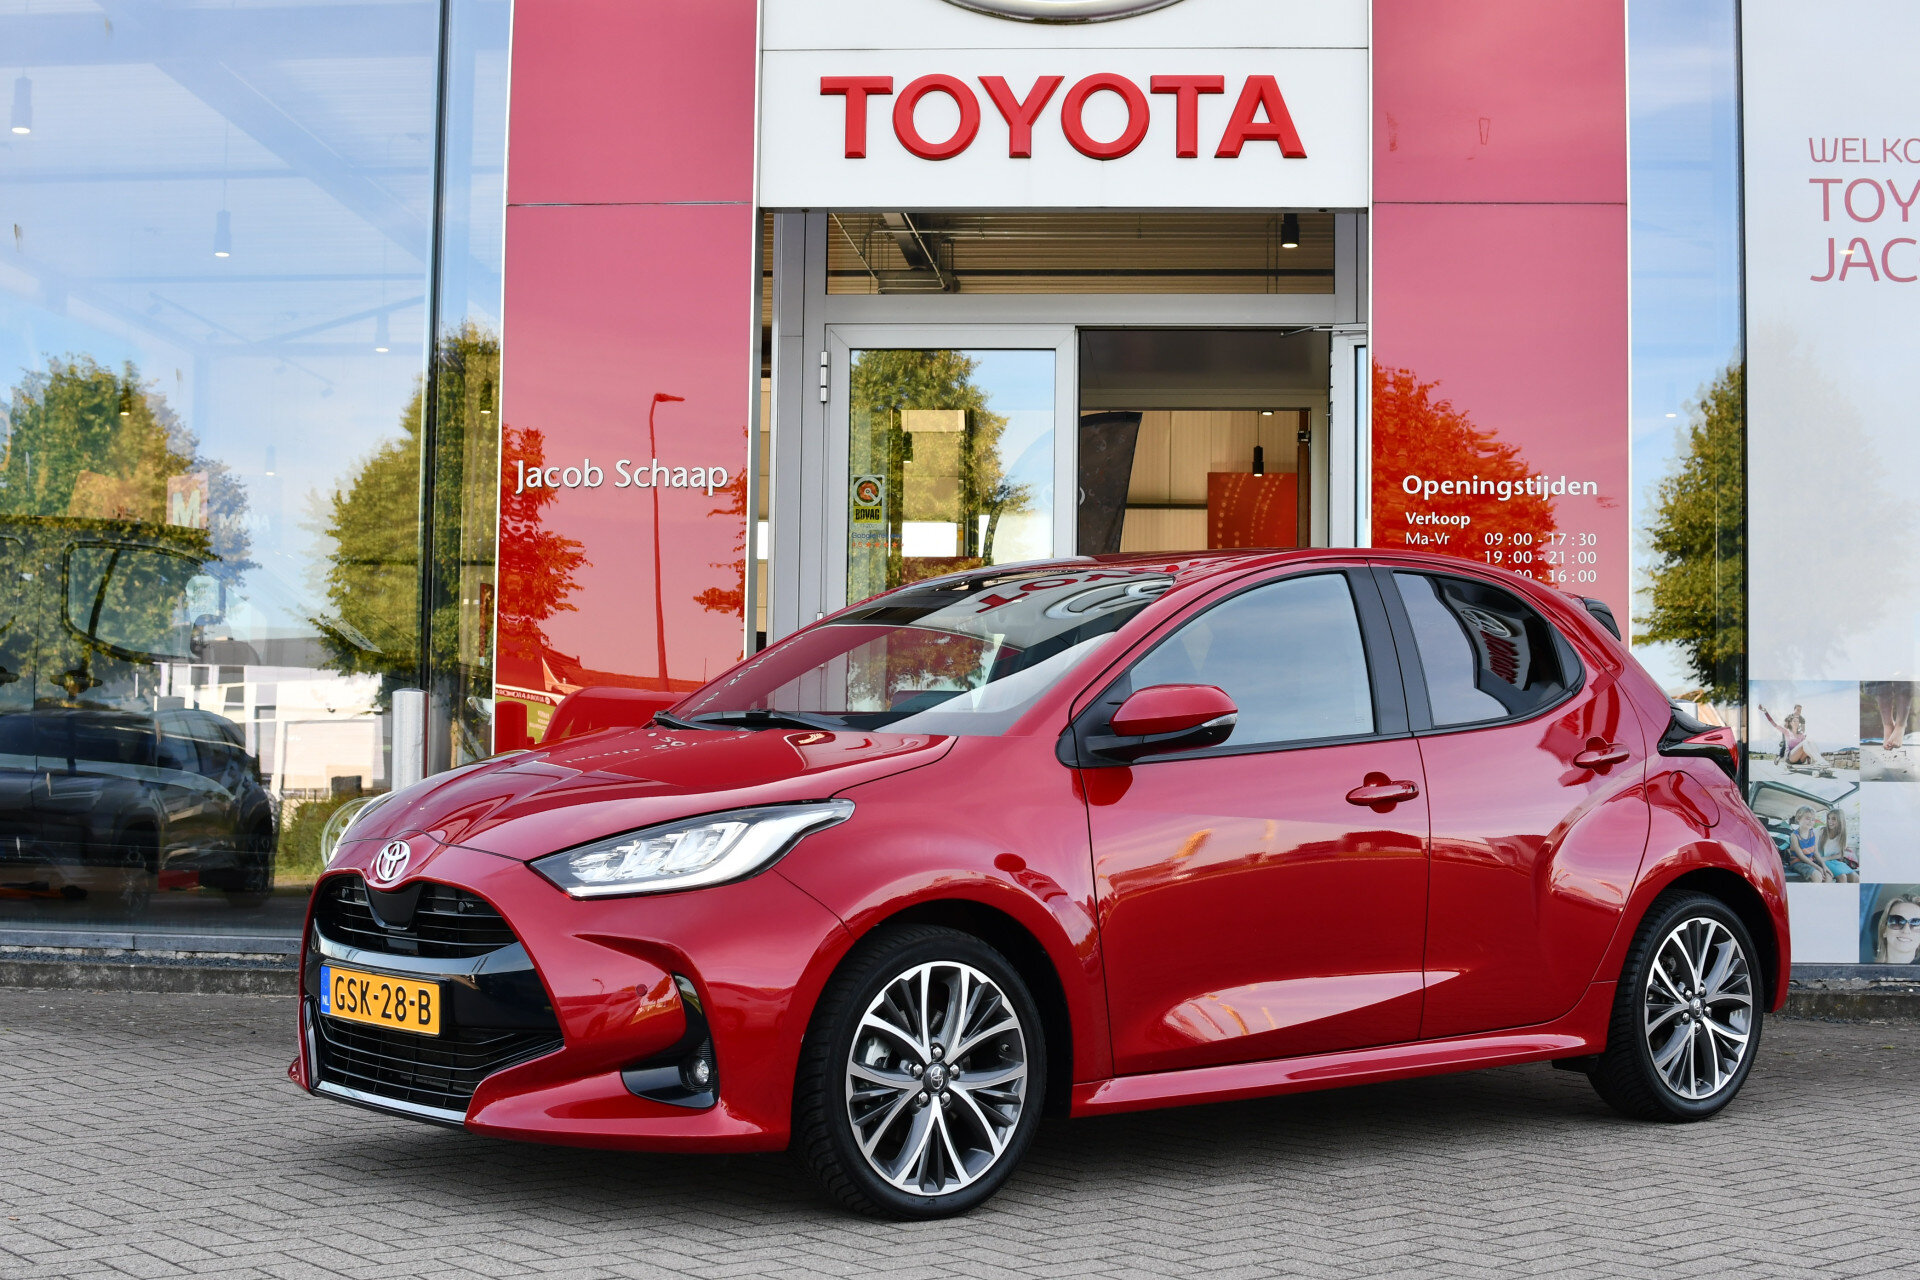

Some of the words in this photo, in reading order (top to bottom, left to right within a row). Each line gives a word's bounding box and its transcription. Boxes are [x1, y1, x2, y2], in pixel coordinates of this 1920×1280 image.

[820, 72, 1308, 161] TOYOTA
[1808, 137, 1920, 164] WELKO
[1808, 178, 1920, 223] TOY
[1809, 237, 1920, 283] JAC
[515, 458, 604, 495] Jacob
[614, 458, 728, 497] Schaap
[1402, 475, 1598, 501] Openingstijden
[855, 508, 880, 520] BOVAG
[1405, 511, 1471, 529] Verkoop
[1405, 532, 1450, 545] Ma-Vr
[322, 995, 330, 1007] NL
[335, 975, 431, 1026] GSK-28-B
